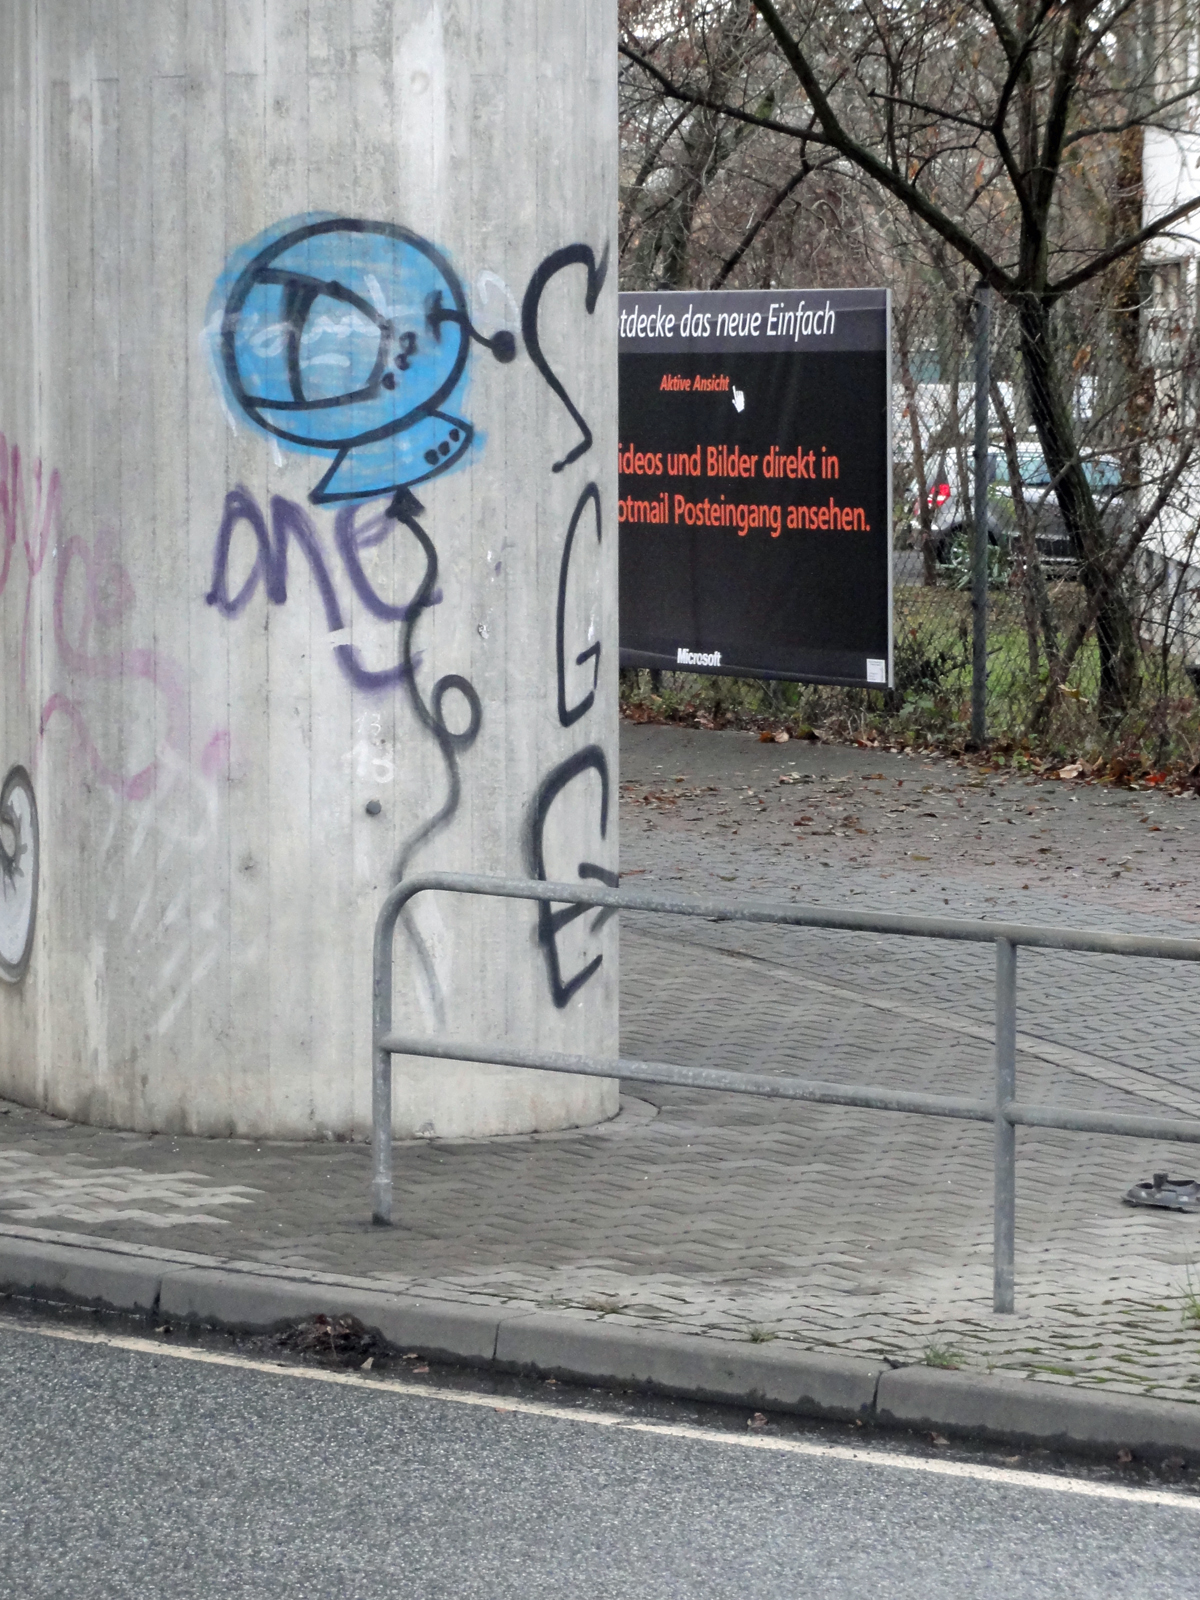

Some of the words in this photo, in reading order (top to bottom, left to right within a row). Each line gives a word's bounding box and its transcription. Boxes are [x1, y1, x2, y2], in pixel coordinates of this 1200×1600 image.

[619, 304, 674, 338] tdecke
[680, 304, 711, 337] das
[716, 311, 762, 336] neue
[766, 300, 836, 342] Einfach
[659, 374, 691, 391] Aktive
[692, 374, 730, 391] Ansicht
[667, 445, 701, 476] und
[706, 445, 758, 478] Bilder
[762, 446, 816, 479] direkt
[821, 446, 840, 479] in
[674, 494, 782, 538] Posteingang
[786, 497, 871, 532] ansehen.
[677, 648, 722, 667] Microsoft
